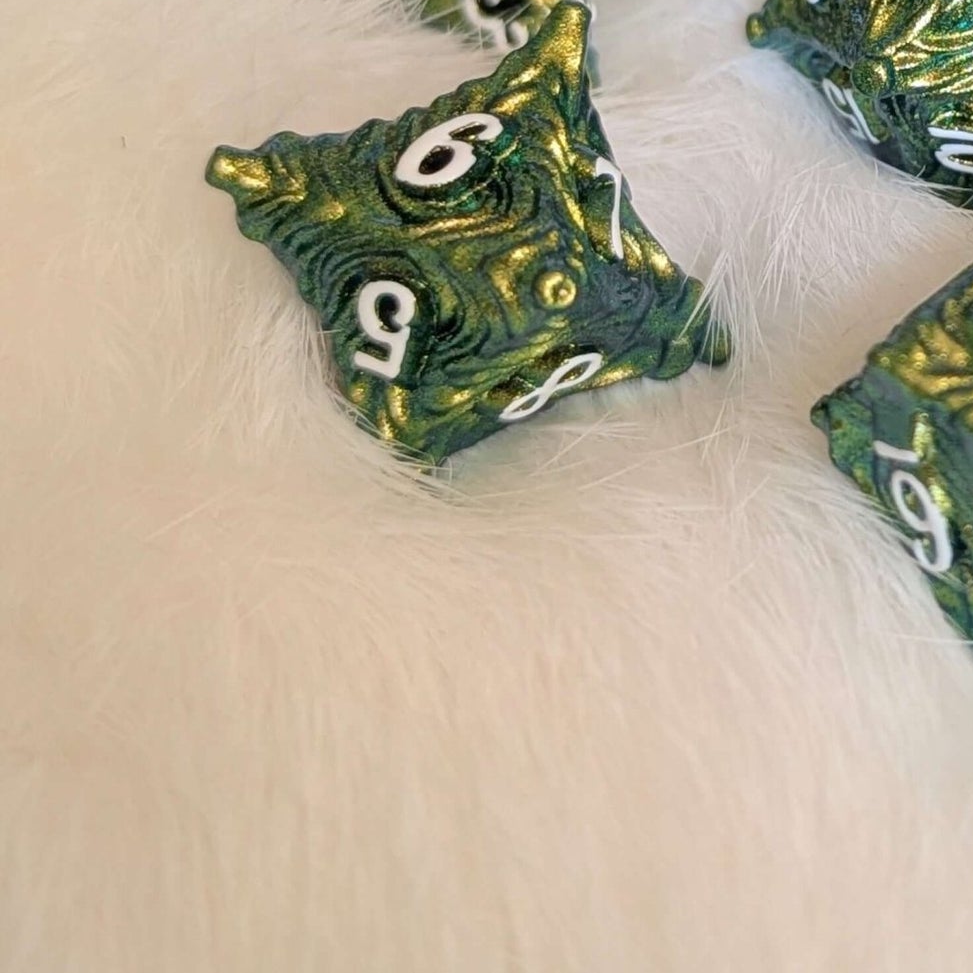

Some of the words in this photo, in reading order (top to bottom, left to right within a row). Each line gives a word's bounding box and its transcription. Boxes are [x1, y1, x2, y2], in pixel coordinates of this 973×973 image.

[394, 112, 504, 189] 6
[594, 155, 626, 261] 7
[354, 279, 417, 380] 5
[500, 351, 605, 422] 8
